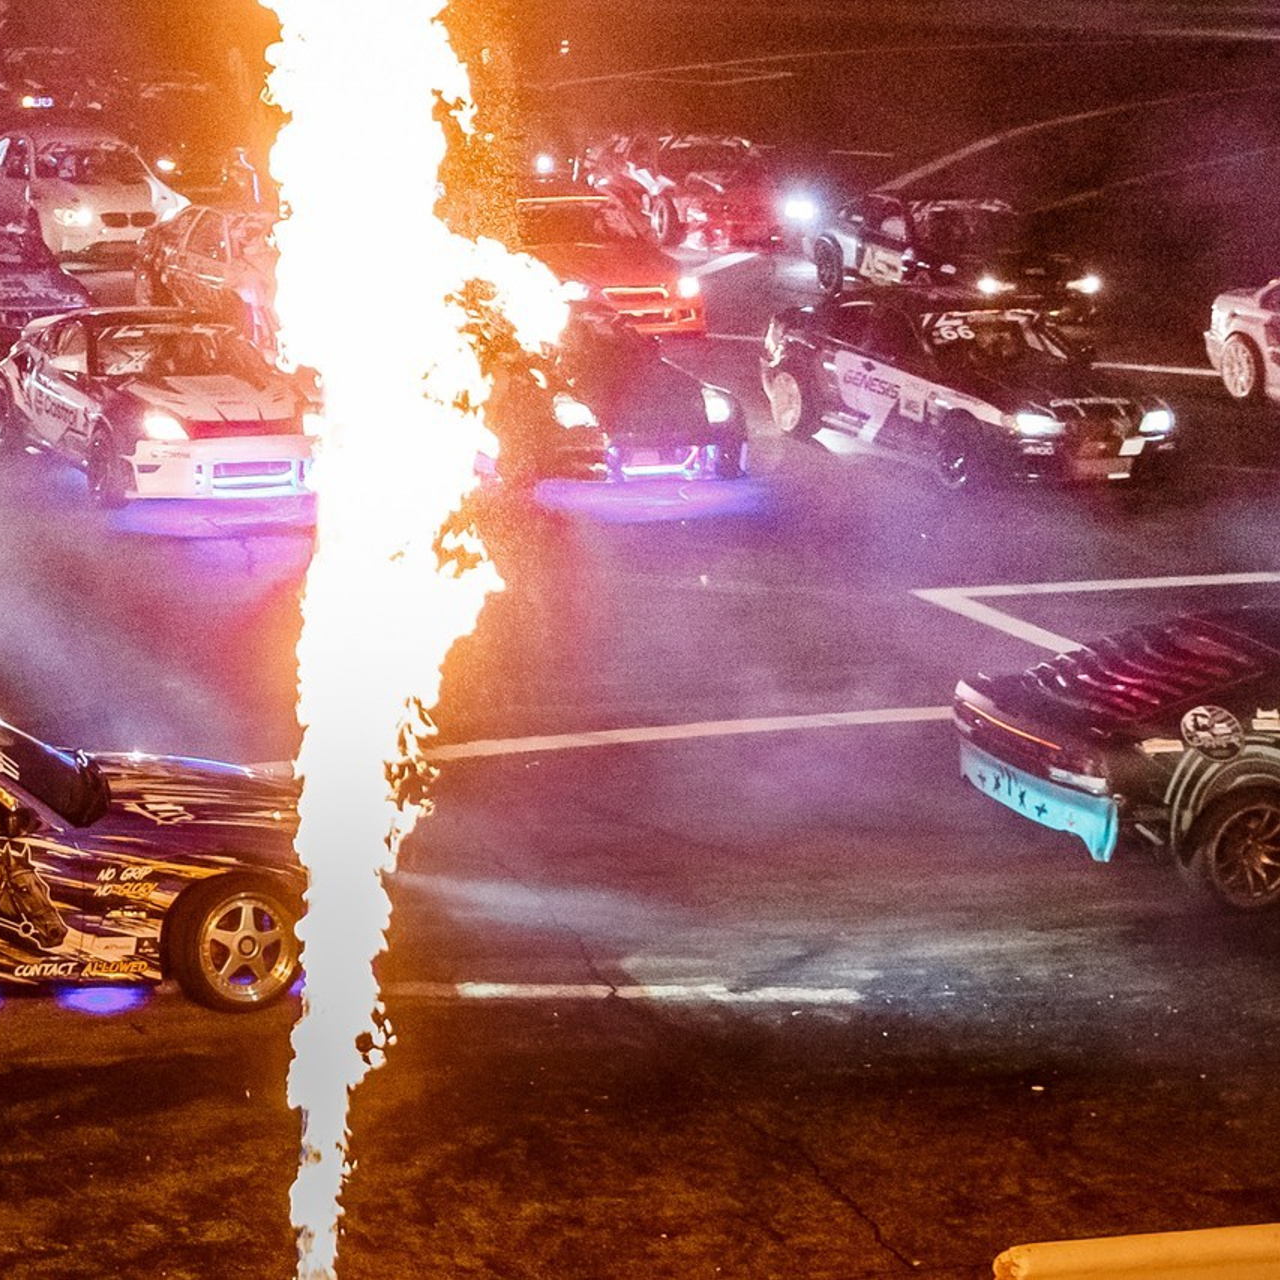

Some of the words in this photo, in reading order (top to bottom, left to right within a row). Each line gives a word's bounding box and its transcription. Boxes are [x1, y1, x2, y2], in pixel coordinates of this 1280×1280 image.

[842, 369, 901, 400] GENESIS
[96, 868, 117, 881] NO
[120, 866, 153, 881] GRIP
[93, 883, 114, 897] NO
[119, 882, 158, 898] GLORY
[14, 962, 78, 977] CONTACT
[81, 960, 148, 977] ALLOWED
